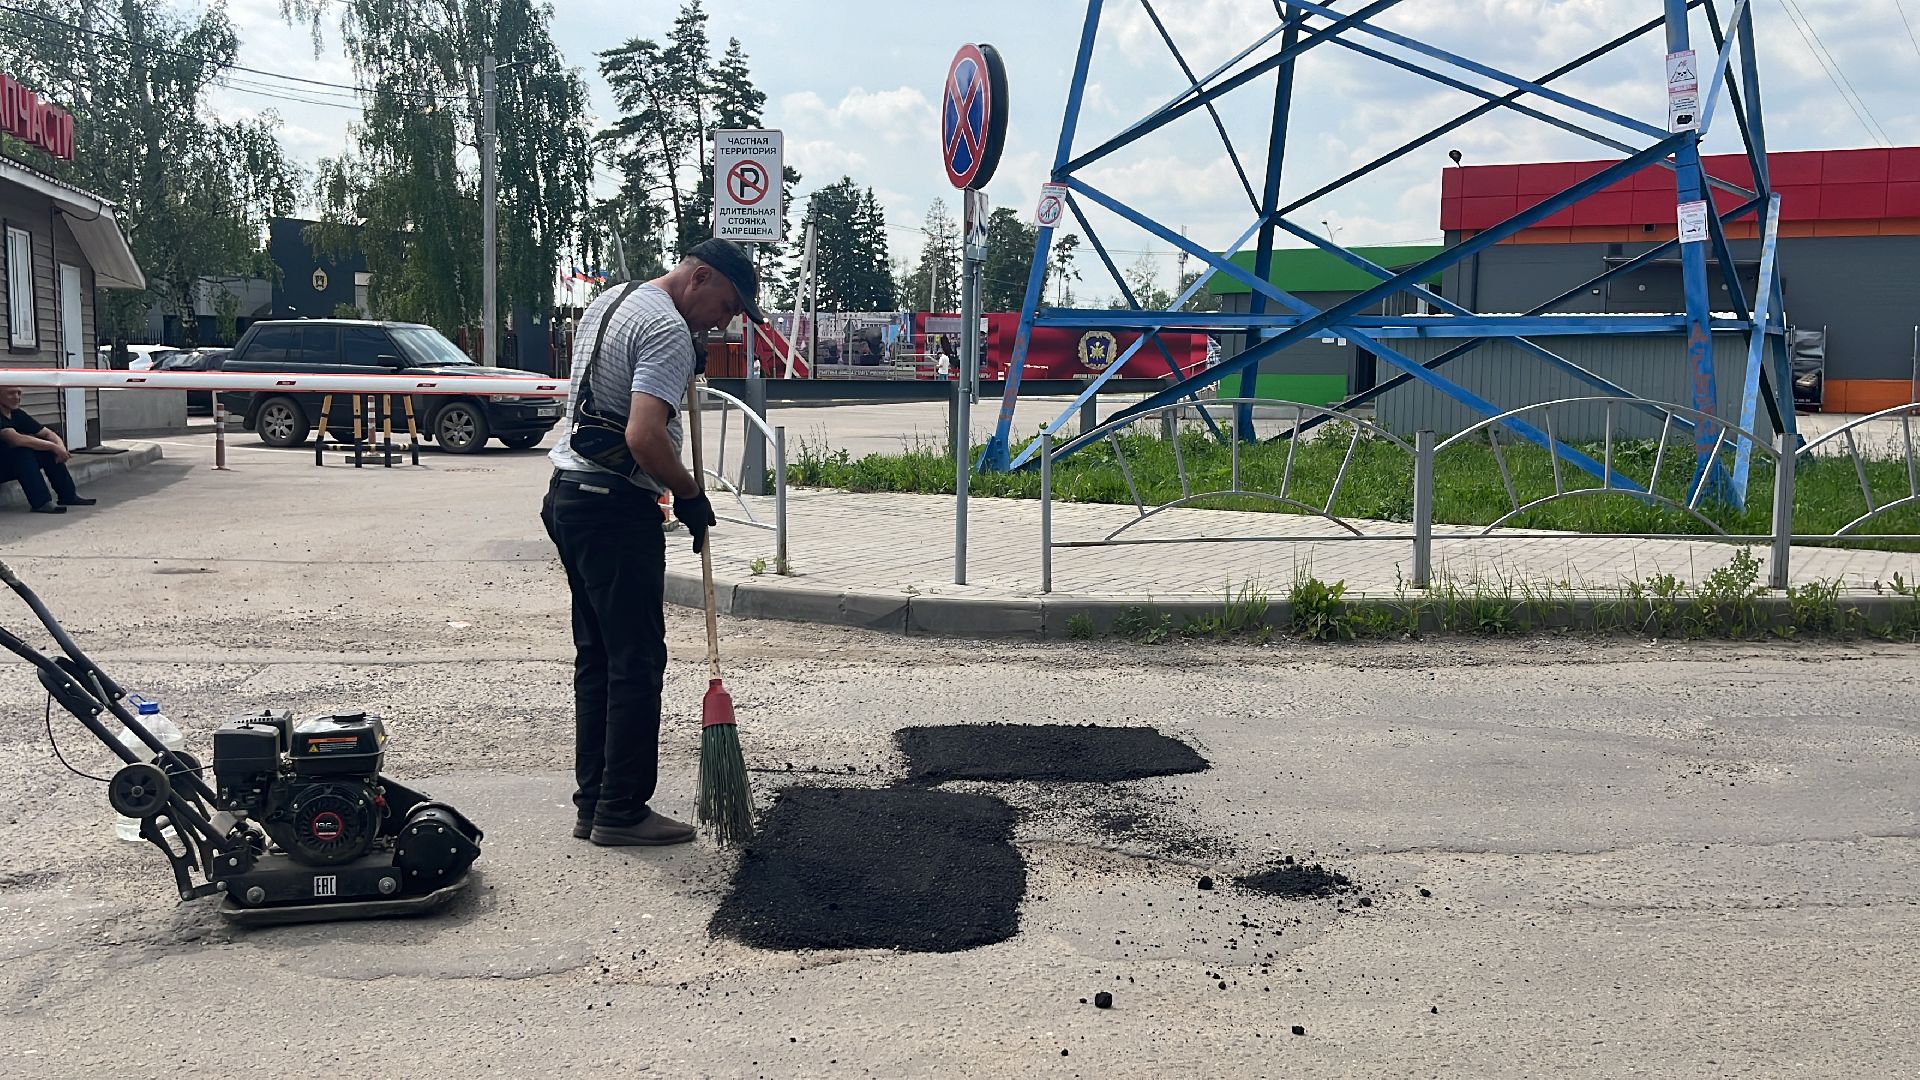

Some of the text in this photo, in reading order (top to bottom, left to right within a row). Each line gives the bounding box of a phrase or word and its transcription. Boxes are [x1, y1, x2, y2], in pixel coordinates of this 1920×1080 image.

[727, 137, 769, 145] ЧАСТНАЯ
[720, 147, 777, 155] ТЕРРИТОРИЯ
[719, 207, 776, 216] ДЛИТЕЛЬНАЯ
[728, 217, 767, 225] СТОЯНКА
[721, 227, 774, 235] ЗАПРЕЩЕНА
